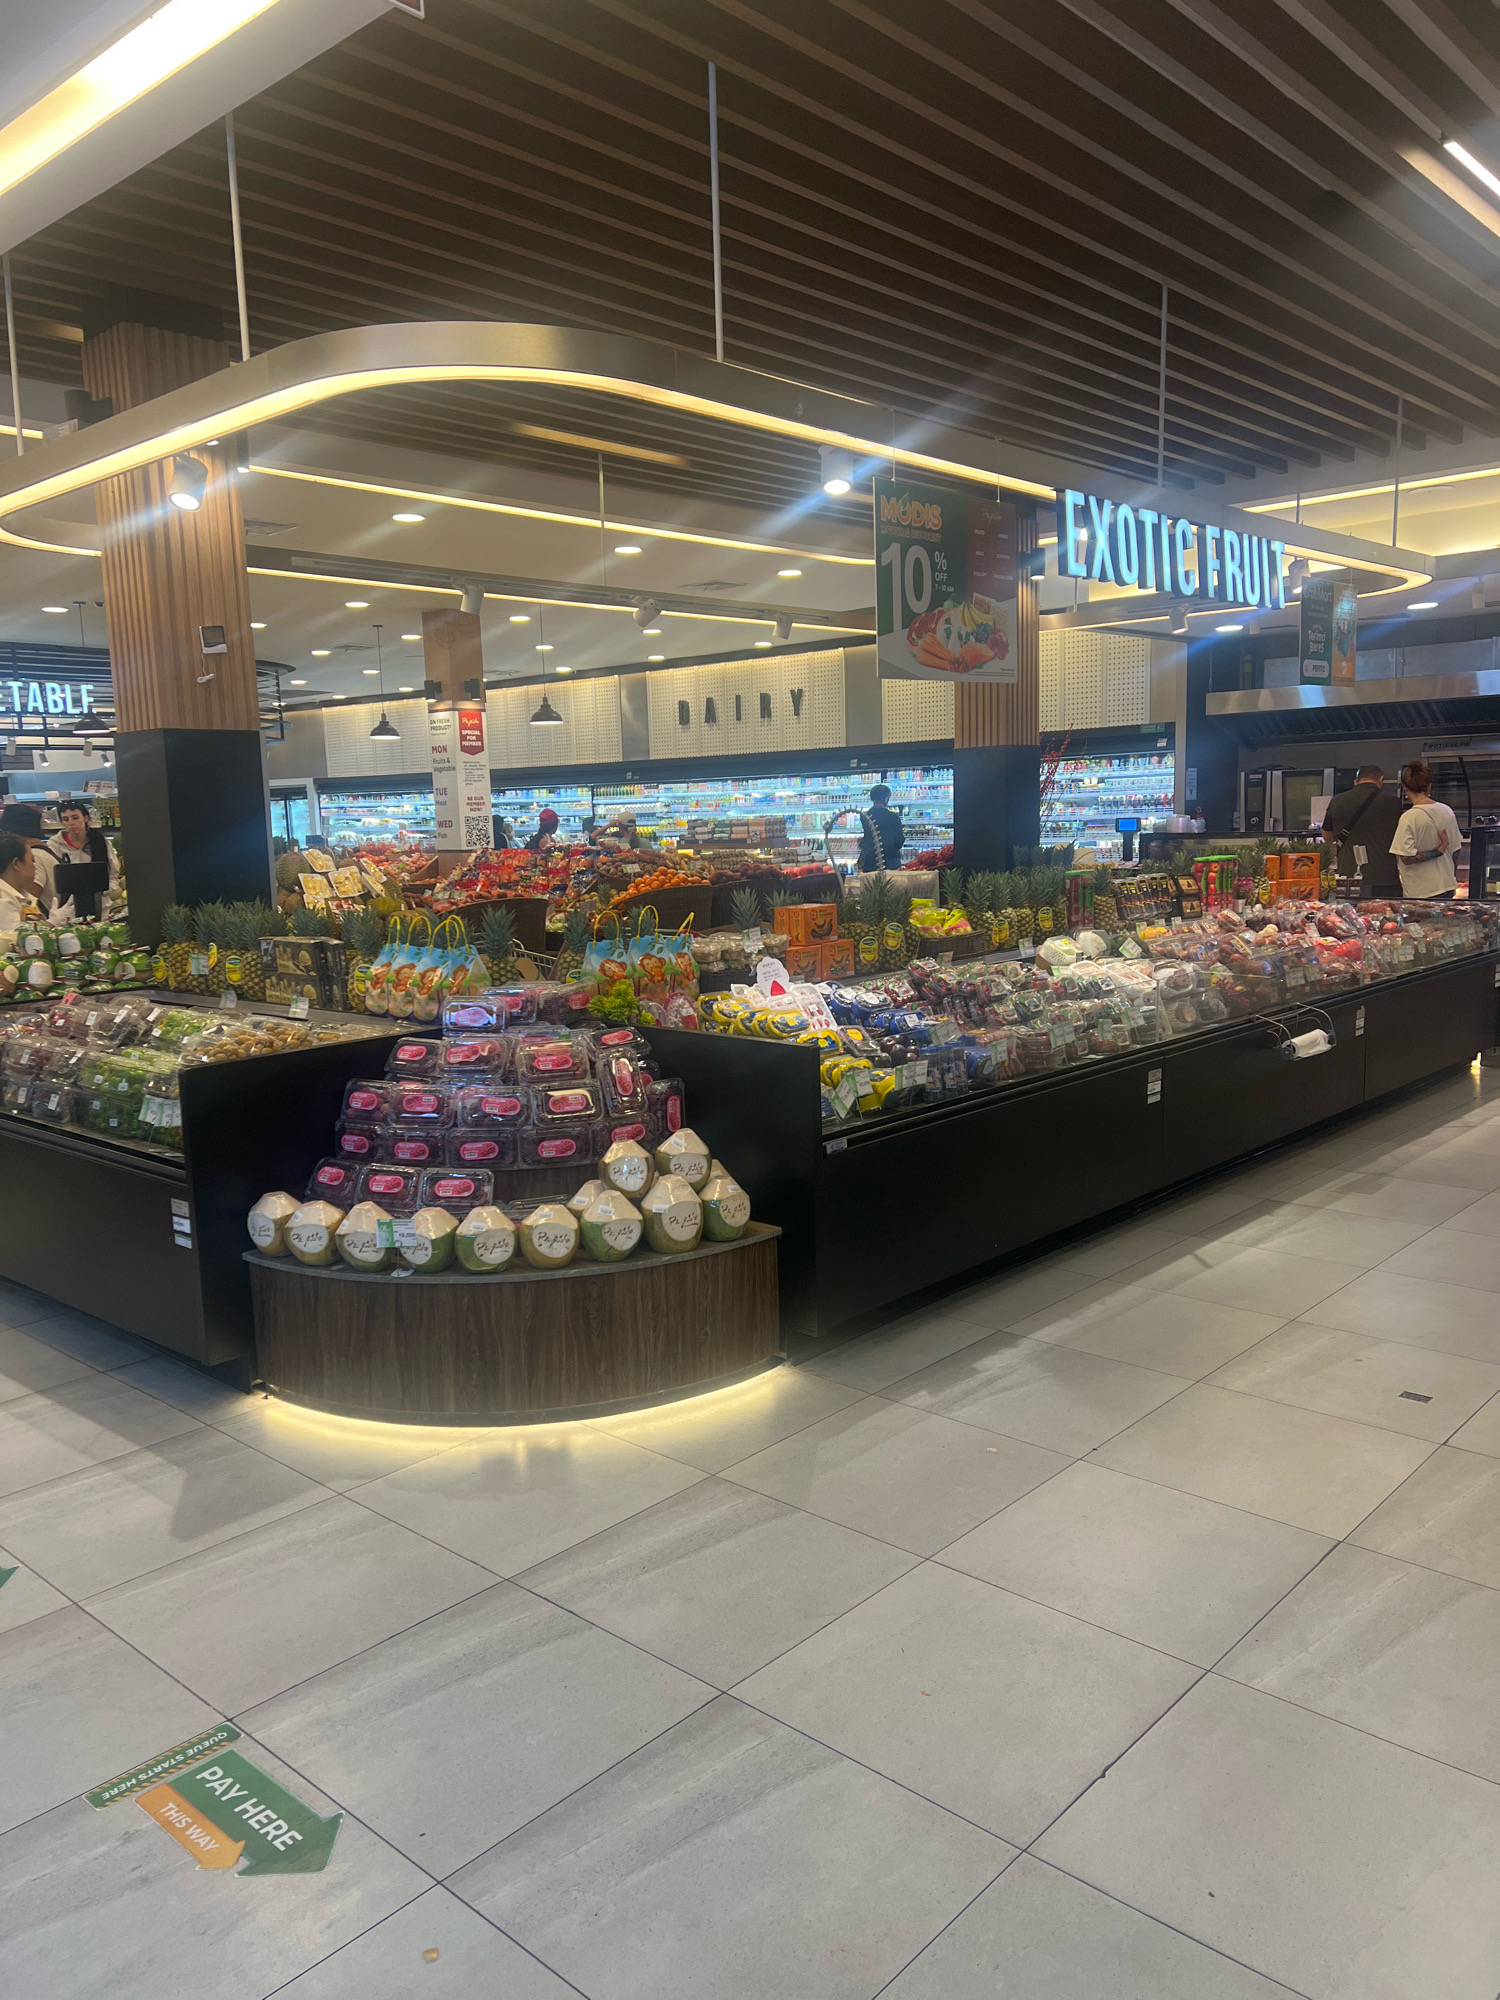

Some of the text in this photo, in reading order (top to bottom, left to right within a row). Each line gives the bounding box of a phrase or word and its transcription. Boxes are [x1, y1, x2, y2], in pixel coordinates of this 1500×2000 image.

[880, 494, 943, 530] MODIS
[934, 551, 948, 571] %
[1065, 488, 1286, 609] EXOTIC FRUIT
[881, 541, 932, 633] 10
[934, 572, 948, 581] OFF
[1312, 664, 1326, 673] PEPITO
[678, 688, 803, 725] DAIRY
[431, 745, 447, 754] MON
[435, 788, 448, 796] TUE
[437, 820, 453, 828] WED
[101, 1731, 228, 1800] QUEUE STARTS HERE
[195, 1765, 303, 1852] PAY HERE
[159, 1802, 221, 1852] THIS WAY
